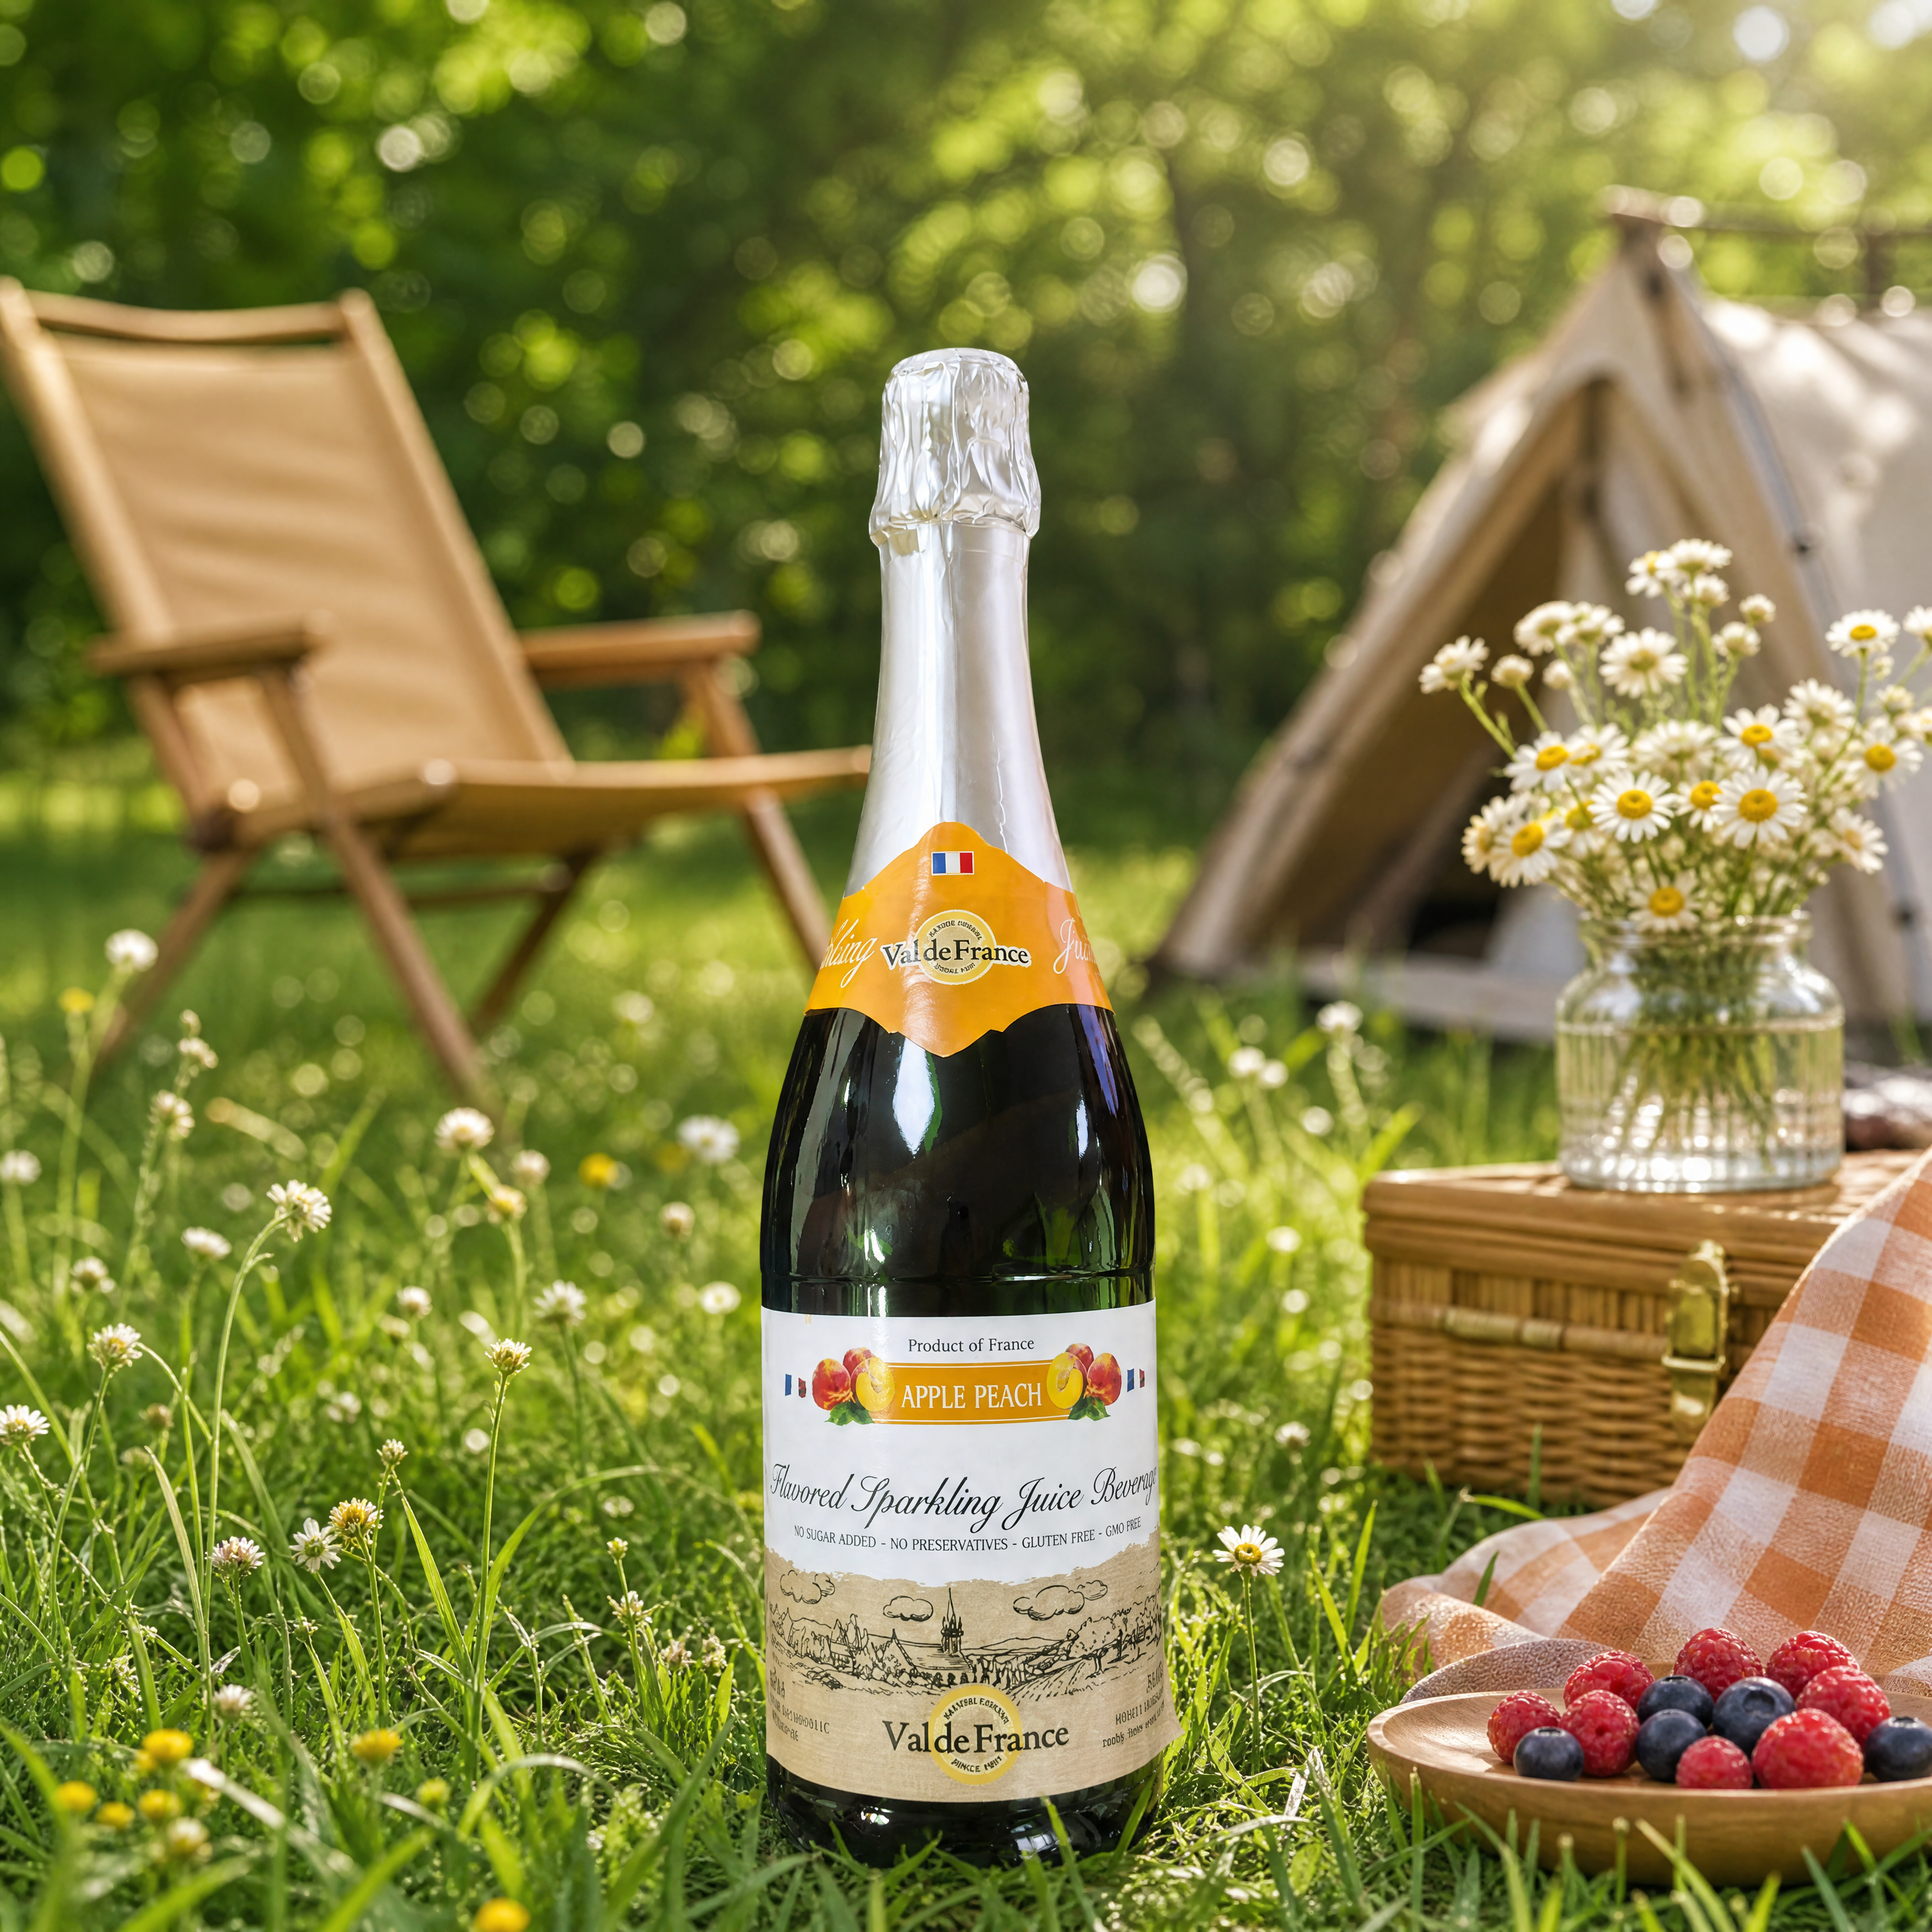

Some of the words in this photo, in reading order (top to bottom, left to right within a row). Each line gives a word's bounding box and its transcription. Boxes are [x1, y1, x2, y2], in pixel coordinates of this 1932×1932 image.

[908, 1338, 964, 1352] Product
[969, 1338, 985, 1352] of
[988, 1338, 1034, 1352] France
[901, 1385, 966, 1409] APPLE
[974, 1383, 1042, 1409] PEACH
[769, 1461, 855, 1511] Flavored
[851, 1474, 1004, 1534] Sparkling
[1002, 1476, 1085, 1531] Juice
[794, 1525, 804, 1538] NO
[806, 1527, 836, 1544] SUGAR
[839, 1534, 876, 1548] ADDED
[890, 1538, 908, 1550] NO
[912, 1538, 1008, 1551] PRESERVATIVES
[1022, 1533, 1067, 1549] GLUTEN
[1071, 1529, 1095, 1544] FREE
[1106, 1522, 1124, 1537] GMO
[1126, 1516, 1141, 1532] FREE
